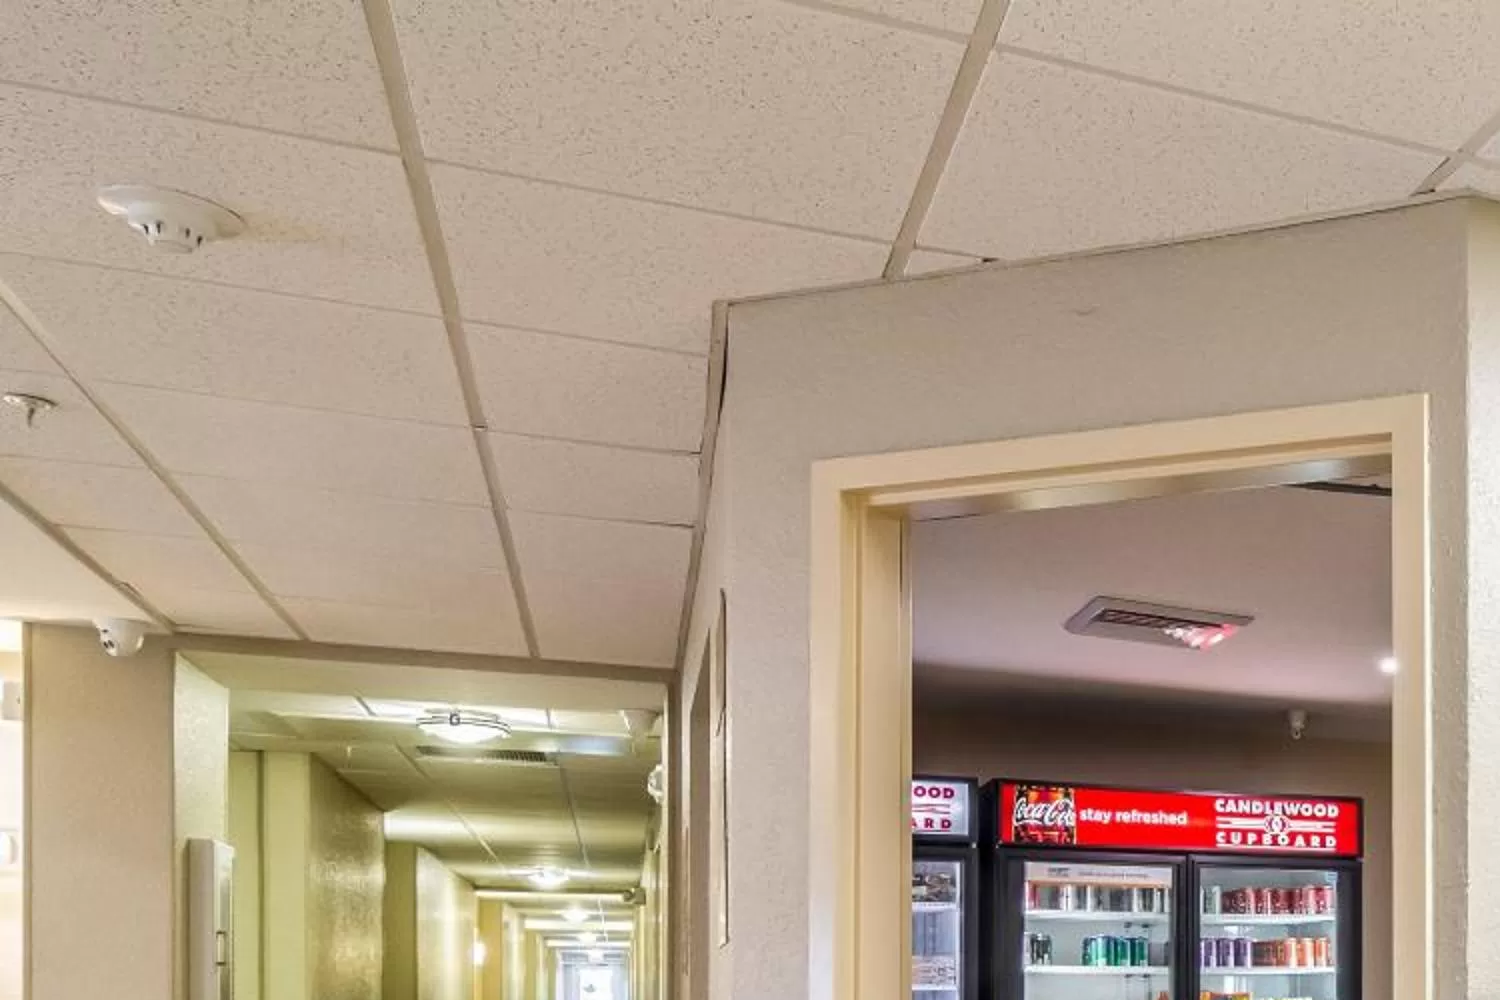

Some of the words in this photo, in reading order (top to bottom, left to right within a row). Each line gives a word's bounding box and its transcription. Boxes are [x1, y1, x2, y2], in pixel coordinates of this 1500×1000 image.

[1215, 798, 1340, 817] CANDLEWOOD
[1080, 808, 1111, 824] stay
[1116, 808, 1188, 827] refreshed
[1215, 831, 1337, 848] CUPBOARD
